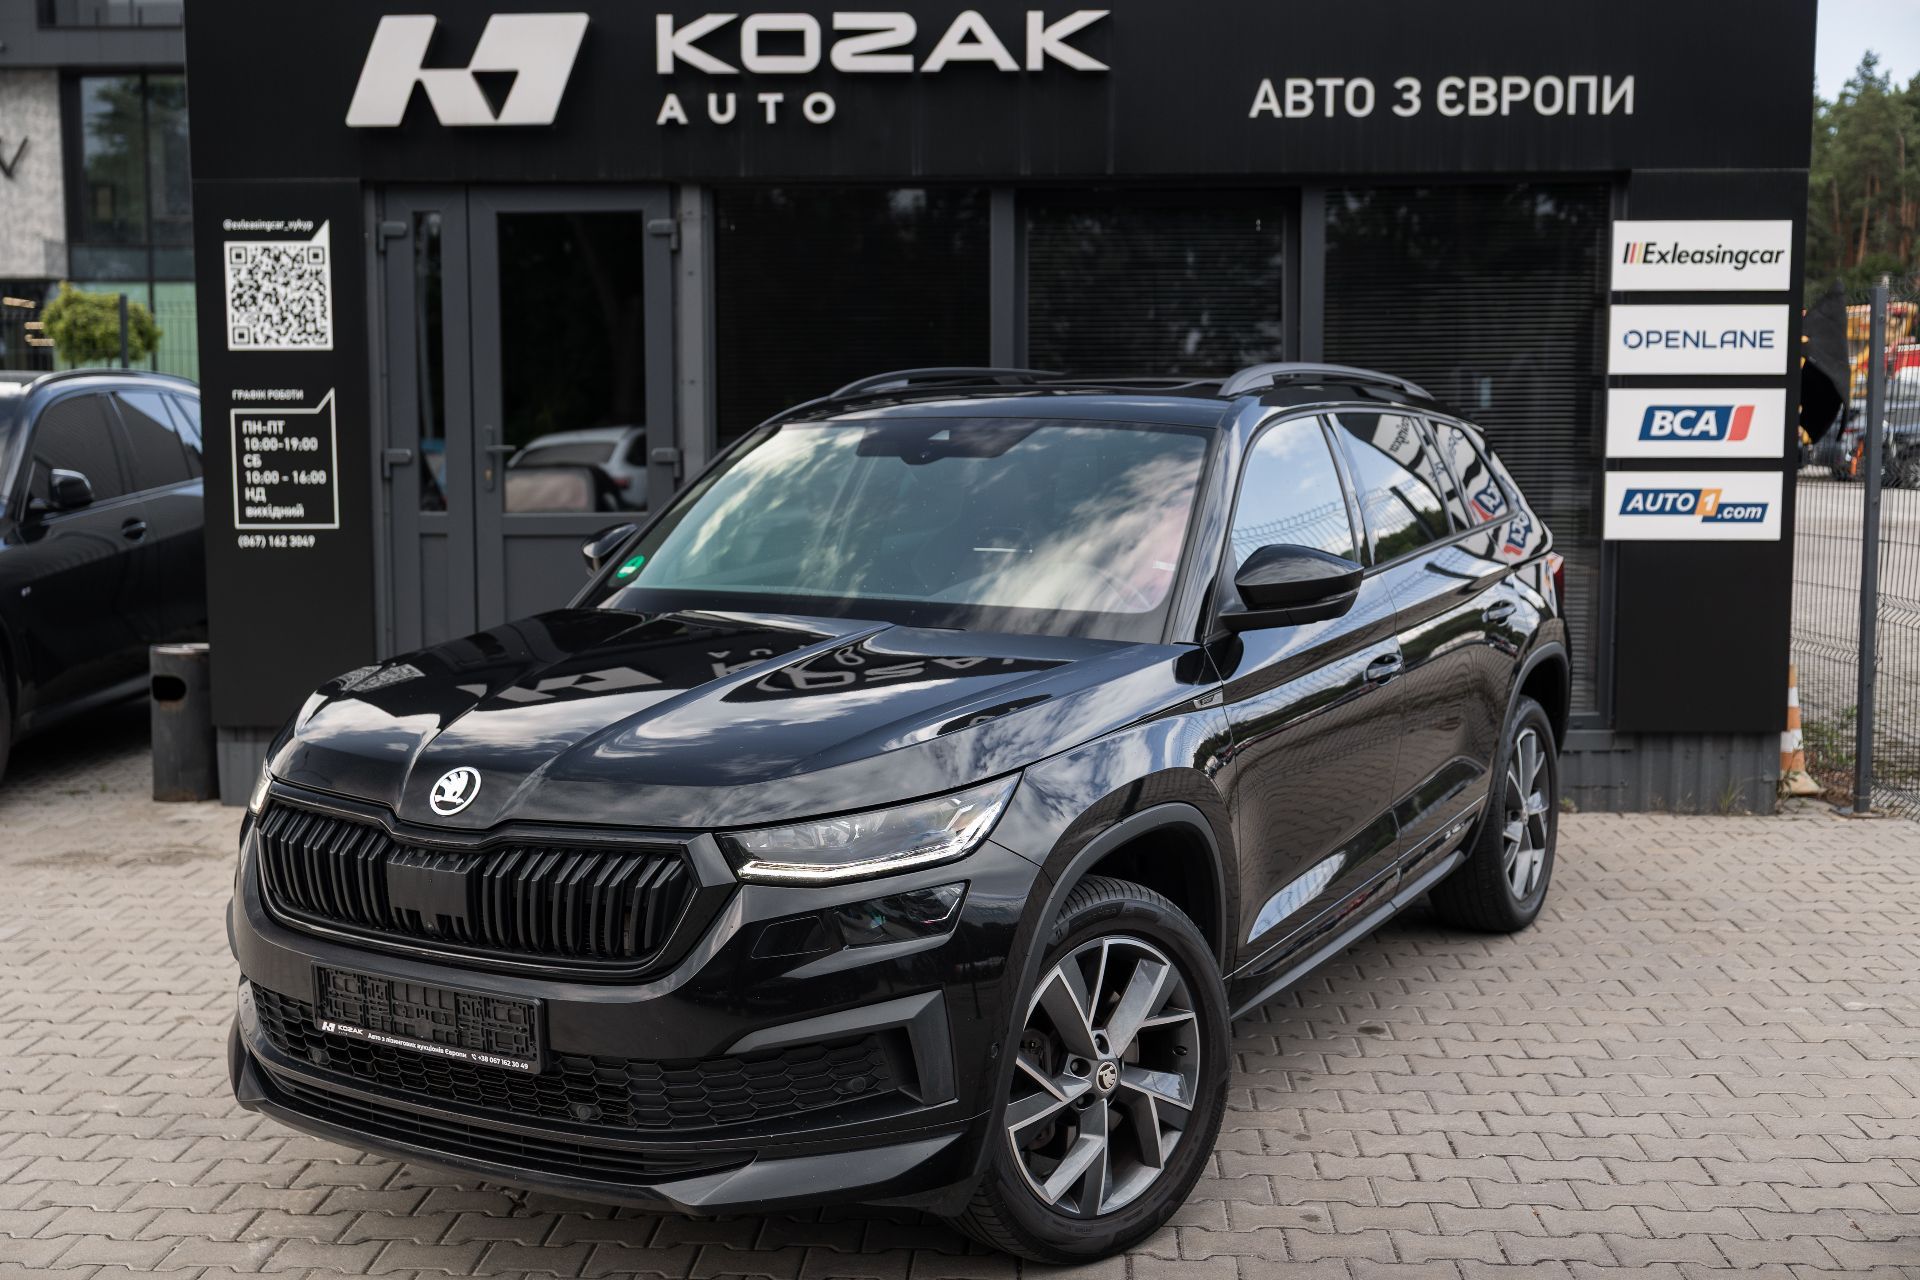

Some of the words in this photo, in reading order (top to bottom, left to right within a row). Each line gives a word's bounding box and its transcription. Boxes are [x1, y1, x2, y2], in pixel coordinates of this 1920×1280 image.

[655, 9, 1112, 74] KOZAK
[1248, 77, 1376, 118] АВТО
[1391, 76, 1422, 117] З
[1436, 75, 1635, 116] ЄВРОПИ
[656, 92, 836, 125] AUTO
[1642, 242, 1785, 270] Exleasingcar
[1623, 330, 1775, 350] OPENLANE
[232, 389, 266, 400] ГРАФІК
[267, 389, 304, 400] РОБОТИ
[242, 420, 285, 435] ПН-ПТ
[1649, 410, 1718, 437] BCA
[243, 454, 262, 468] СБ
[245, 470, 279, 484] 10:00
[292, 470, 327, 484] 16:00
[245, 487, 267, 503] НД
[238, 535, 266, 549] (067)
[268, 535, 287, 547] 162
[338, 1024, 363, 1035] KOZAK
[501, 1059, 511, 1067] 162
